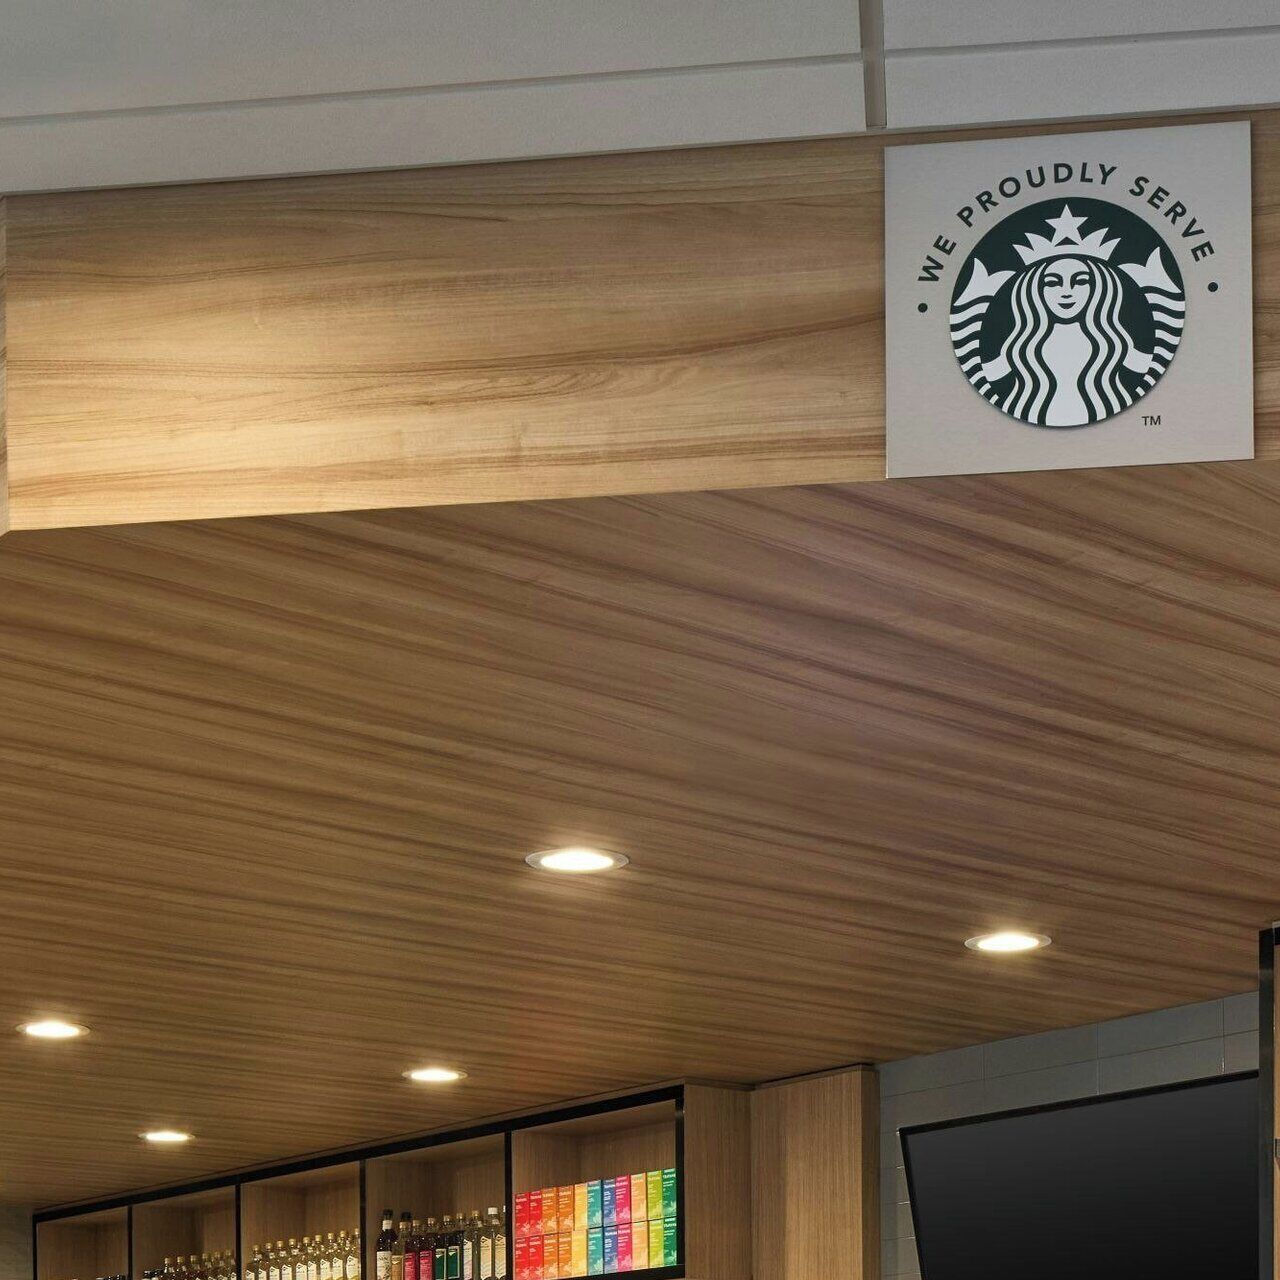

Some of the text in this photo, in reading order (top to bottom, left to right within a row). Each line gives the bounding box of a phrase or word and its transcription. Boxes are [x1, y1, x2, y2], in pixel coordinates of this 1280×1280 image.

[918, 161, 1215, 283] WE PROUDLY SERVE
[1141, 415, 1162, 427] TM
